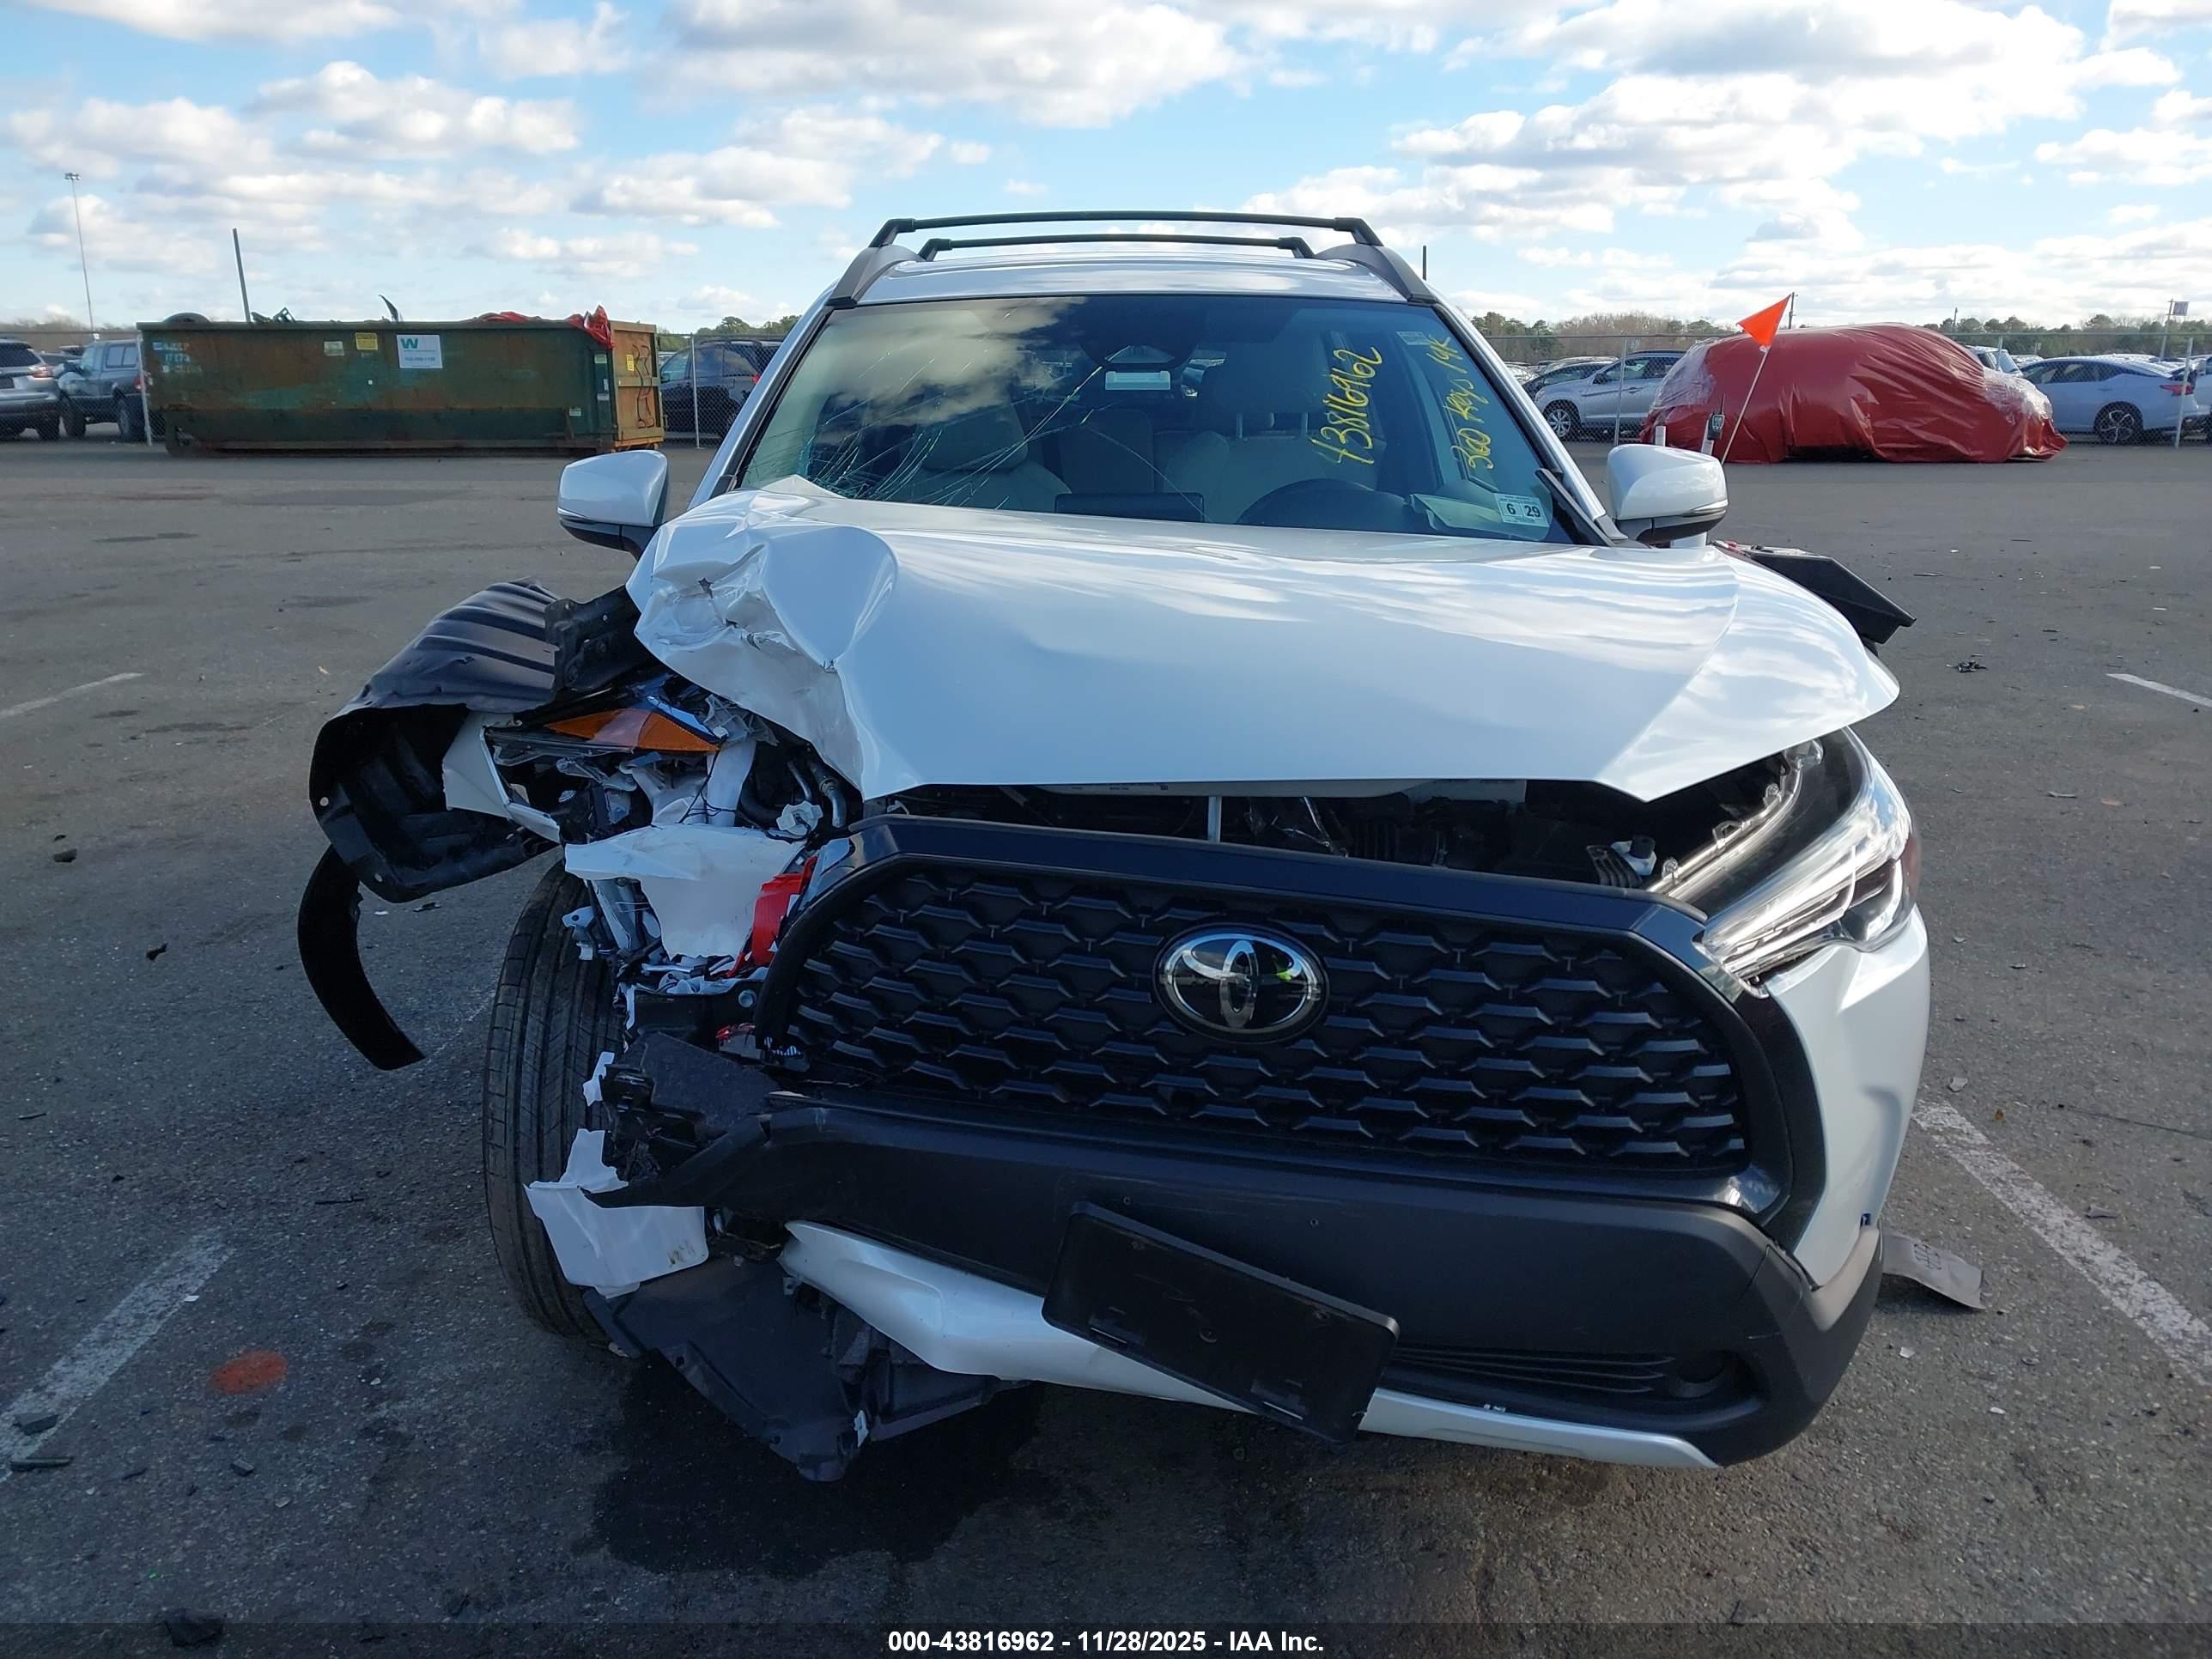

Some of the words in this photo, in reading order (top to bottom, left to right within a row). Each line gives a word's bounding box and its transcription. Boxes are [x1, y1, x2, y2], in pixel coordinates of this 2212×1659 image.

[1310, 347, 1382, 465] 43816962
[1506, 503, 1516, 515] 6
[1524, 505, 1540, 517] 29
